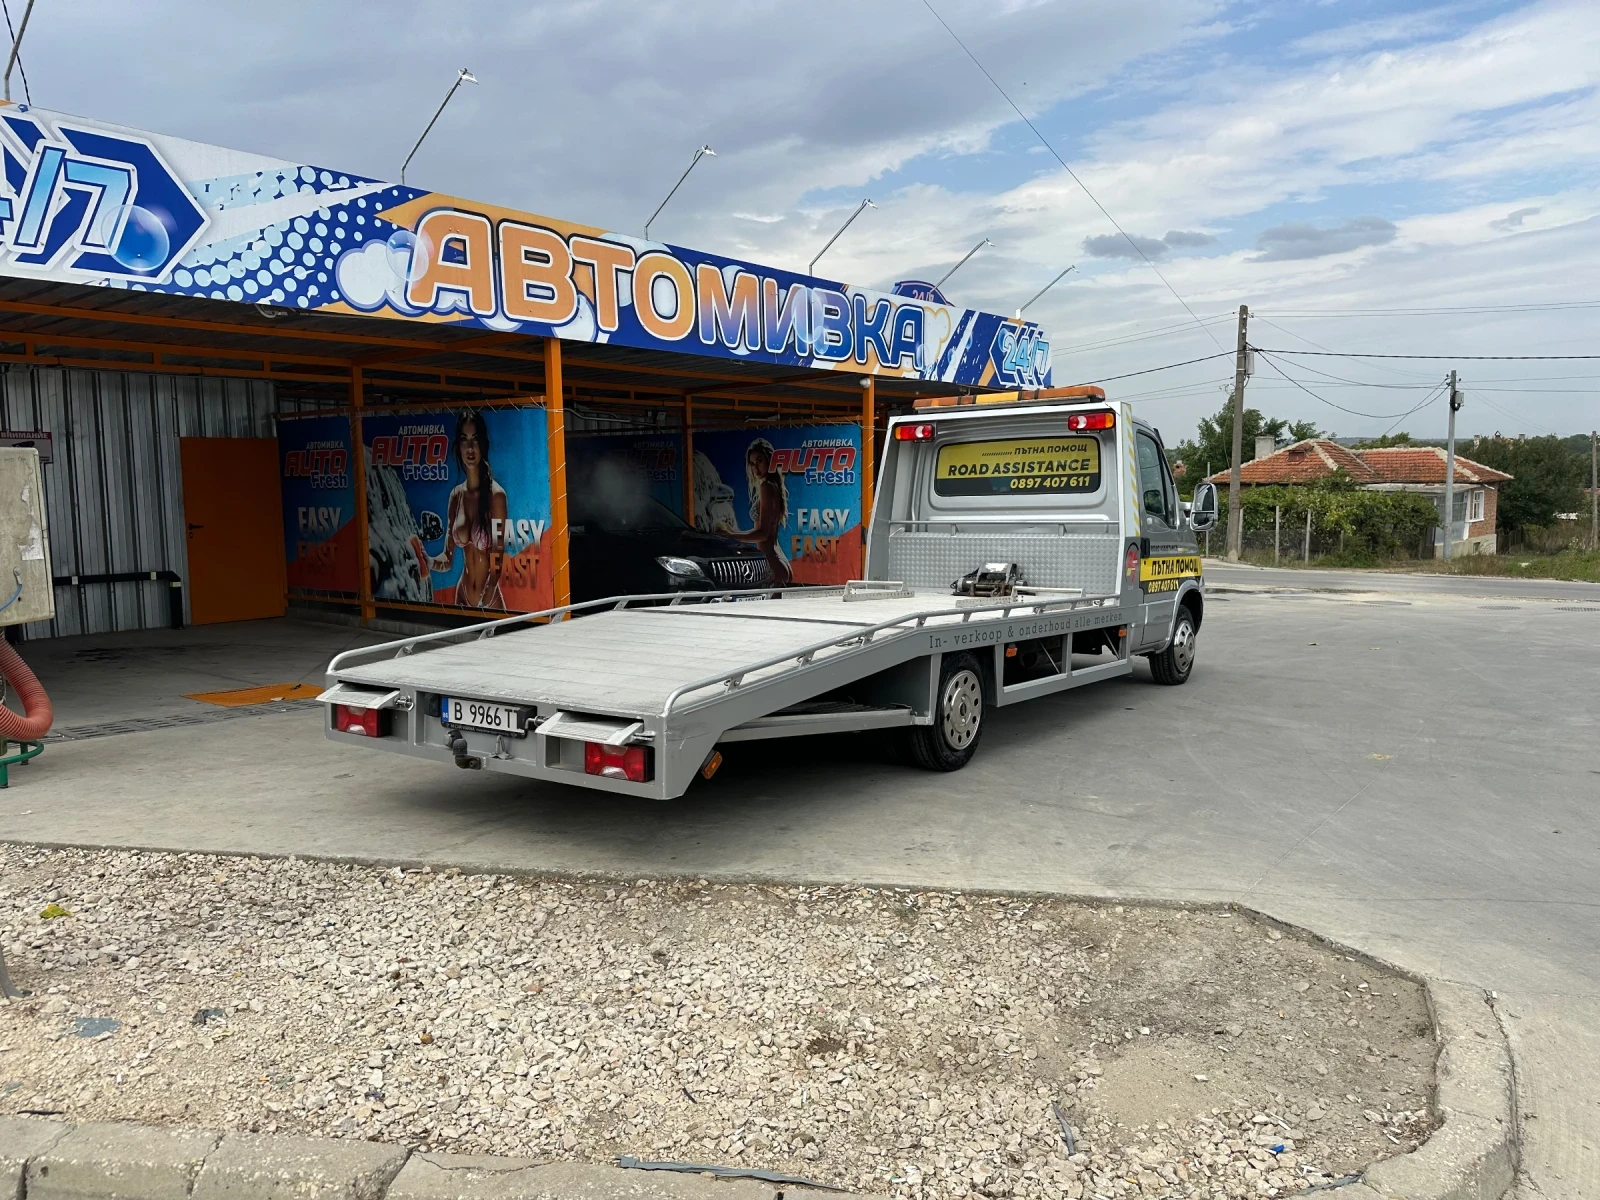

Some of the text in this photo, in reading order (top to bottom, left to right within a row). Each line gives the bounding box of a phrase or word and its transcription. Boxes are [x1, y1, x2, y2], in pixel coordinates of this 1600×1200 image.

[406, 208, 926, 370] АВТОМИВКА
[1003, 333, 1050, 378] 24/7
[398, 425, 446, 436] АВТОМИВКА
[801, 438, 853, 448] АВТОМИВКА
[306, 440, 344, 450] АВТОМИВКА
[371, 436, 449, 466] AUTO
[1014, 443, 1088, 455] ПЪТНА ПОМОЩ
[284, 449, 347, 477] AUTO
[403, 459, 449, 481] Fresh
[768, 447, 857, 473] AUTO
[948, 458, 1091, 477] ROAD ASSISTANCE
[310, 471, 349, 489] Fresh
[805, 467, 855, 485] Fresh
[1010, 475, 1090, 489] 0897 407 611
[297, 506, 342, 535] EASY
[797, 508, 850, 535] EASY
[491, 518, 545, 551] EASY
[791, 535, 840, 564] FAST
[489, 553, 540, 588] FAST
[1151, 560, 1174, 576] ПЪТНА
[1175, 558, 1199, 575] ПОМОЩ
[954, 629, 1002, 645] verkoop
[1007, 626, 1014, 638] &
[1019, 618, 1071, 637] onderhoud
[1074, 616, 1091, 628] alle
[1094, 612, 1123, 625] merken
[454, 702, 463, 721] B
[469, 704, 502, 726] 9966
